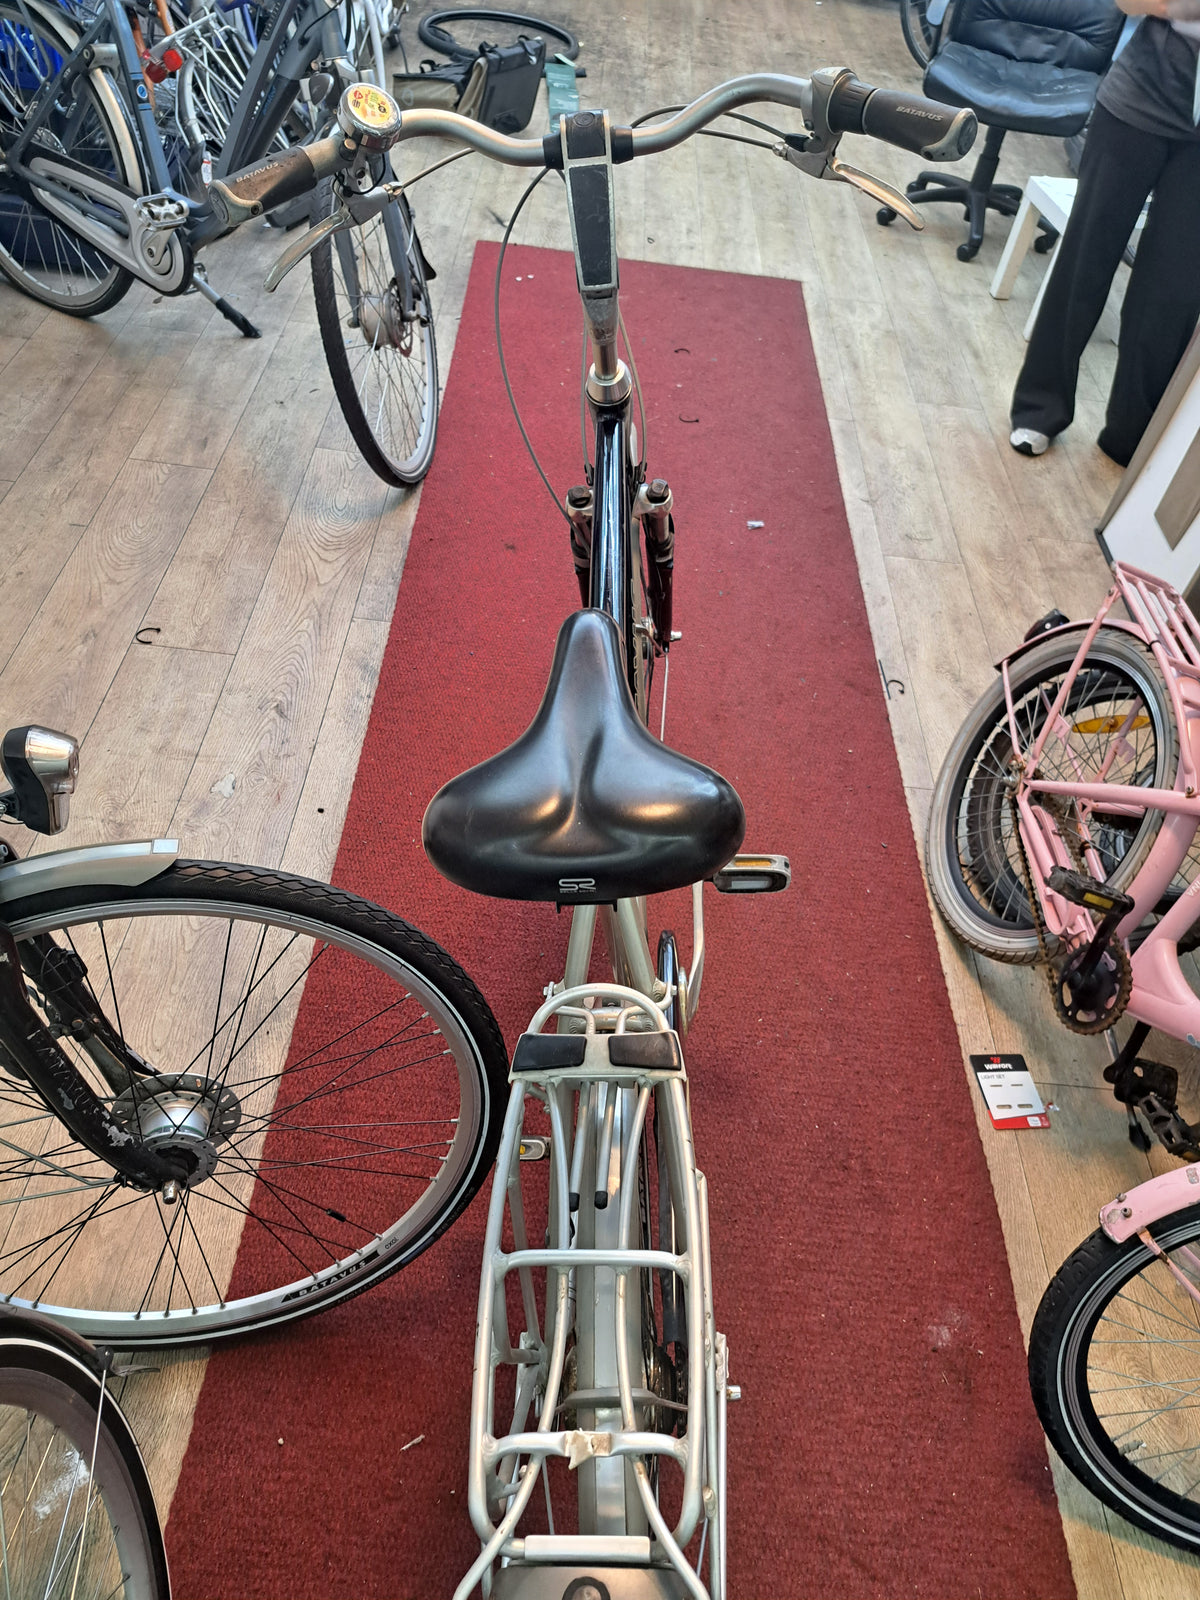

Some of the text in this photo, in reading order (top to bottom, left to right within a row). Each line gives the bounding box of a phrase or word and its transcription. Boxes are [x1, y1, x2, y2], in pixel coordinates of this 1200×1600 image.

[896, 106, 944, 121] BATAVUS
[236, 161, 279, 183] BATAVUS
[299, 1260, 367, 1296] BATAVUS
